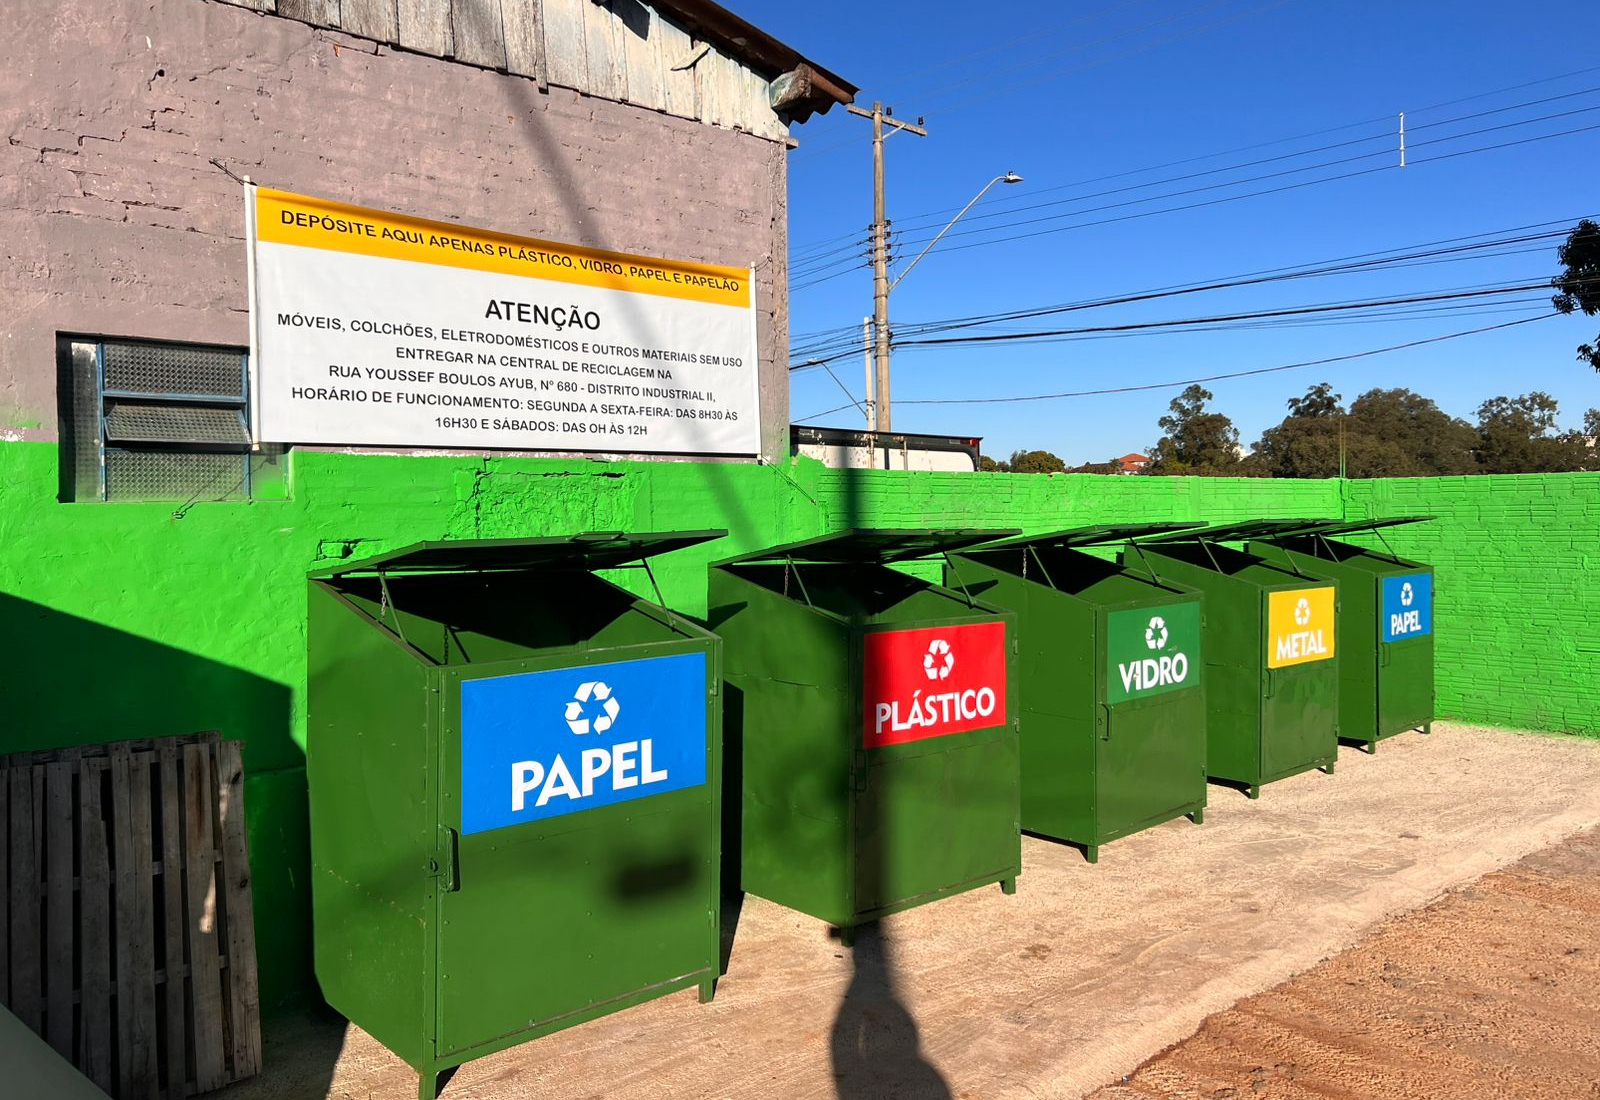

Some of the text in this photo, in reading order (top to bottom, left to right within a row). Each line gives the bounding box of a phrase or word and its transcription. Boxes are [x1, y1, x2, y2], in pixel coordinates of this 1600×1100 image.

[281, 211, 739, 291] DEPÓSITE AQUI APENAS PLÁSTICO, VIDRO, PAPEL E PAPELÃO
[486, 300, 600, 331] ATENÇÃO
[278, 312, 742, 367] MÓVEIS, COLCHÕES, ELETRODOMÉSTICOS E OUTROS MATERIAIS SEM USO
[396, 347, 672, 379] ENTREGAR NA CENTRAL DE RECICLAGEM NA
[330, 366, 361, 378] RUA
[366, 368, 434, 382] YOUSSEF
[439, 373, 495, 386] BOULOS
[500, 377, 536, 391] AYUB,
[557, 381, 577, 392] 680
[588, 384, 639, 396] DISTRITO
[643, 388, 704, 400] INDUSTRIAL
[707, 392, 715, 402] II,
[292, 386, 738, 420] HORÁRIO DE FUNCIONAMENTO: SEGUNDA A SEXTA-FEIRA: DAS 8H30 ÀS
[434, 417, 477, 428] 16H30
[481, 419, 489, 429] E
[494, 418, 558, 432] SÁBADOS:
[563, 422, 586, 432] DAS
[610, 422, 624, 434] ÀS
[628, 426, 647, 435] 12H
[1392, 610, 1421, 635] PAPEL
[1277, 630, 1327, 660] METAL
[1119, 653, 1187, 692] VIDRO
[877, 687, 995, 733] PLÁSTICO
[512, 739, 667, 811] PAPEL
